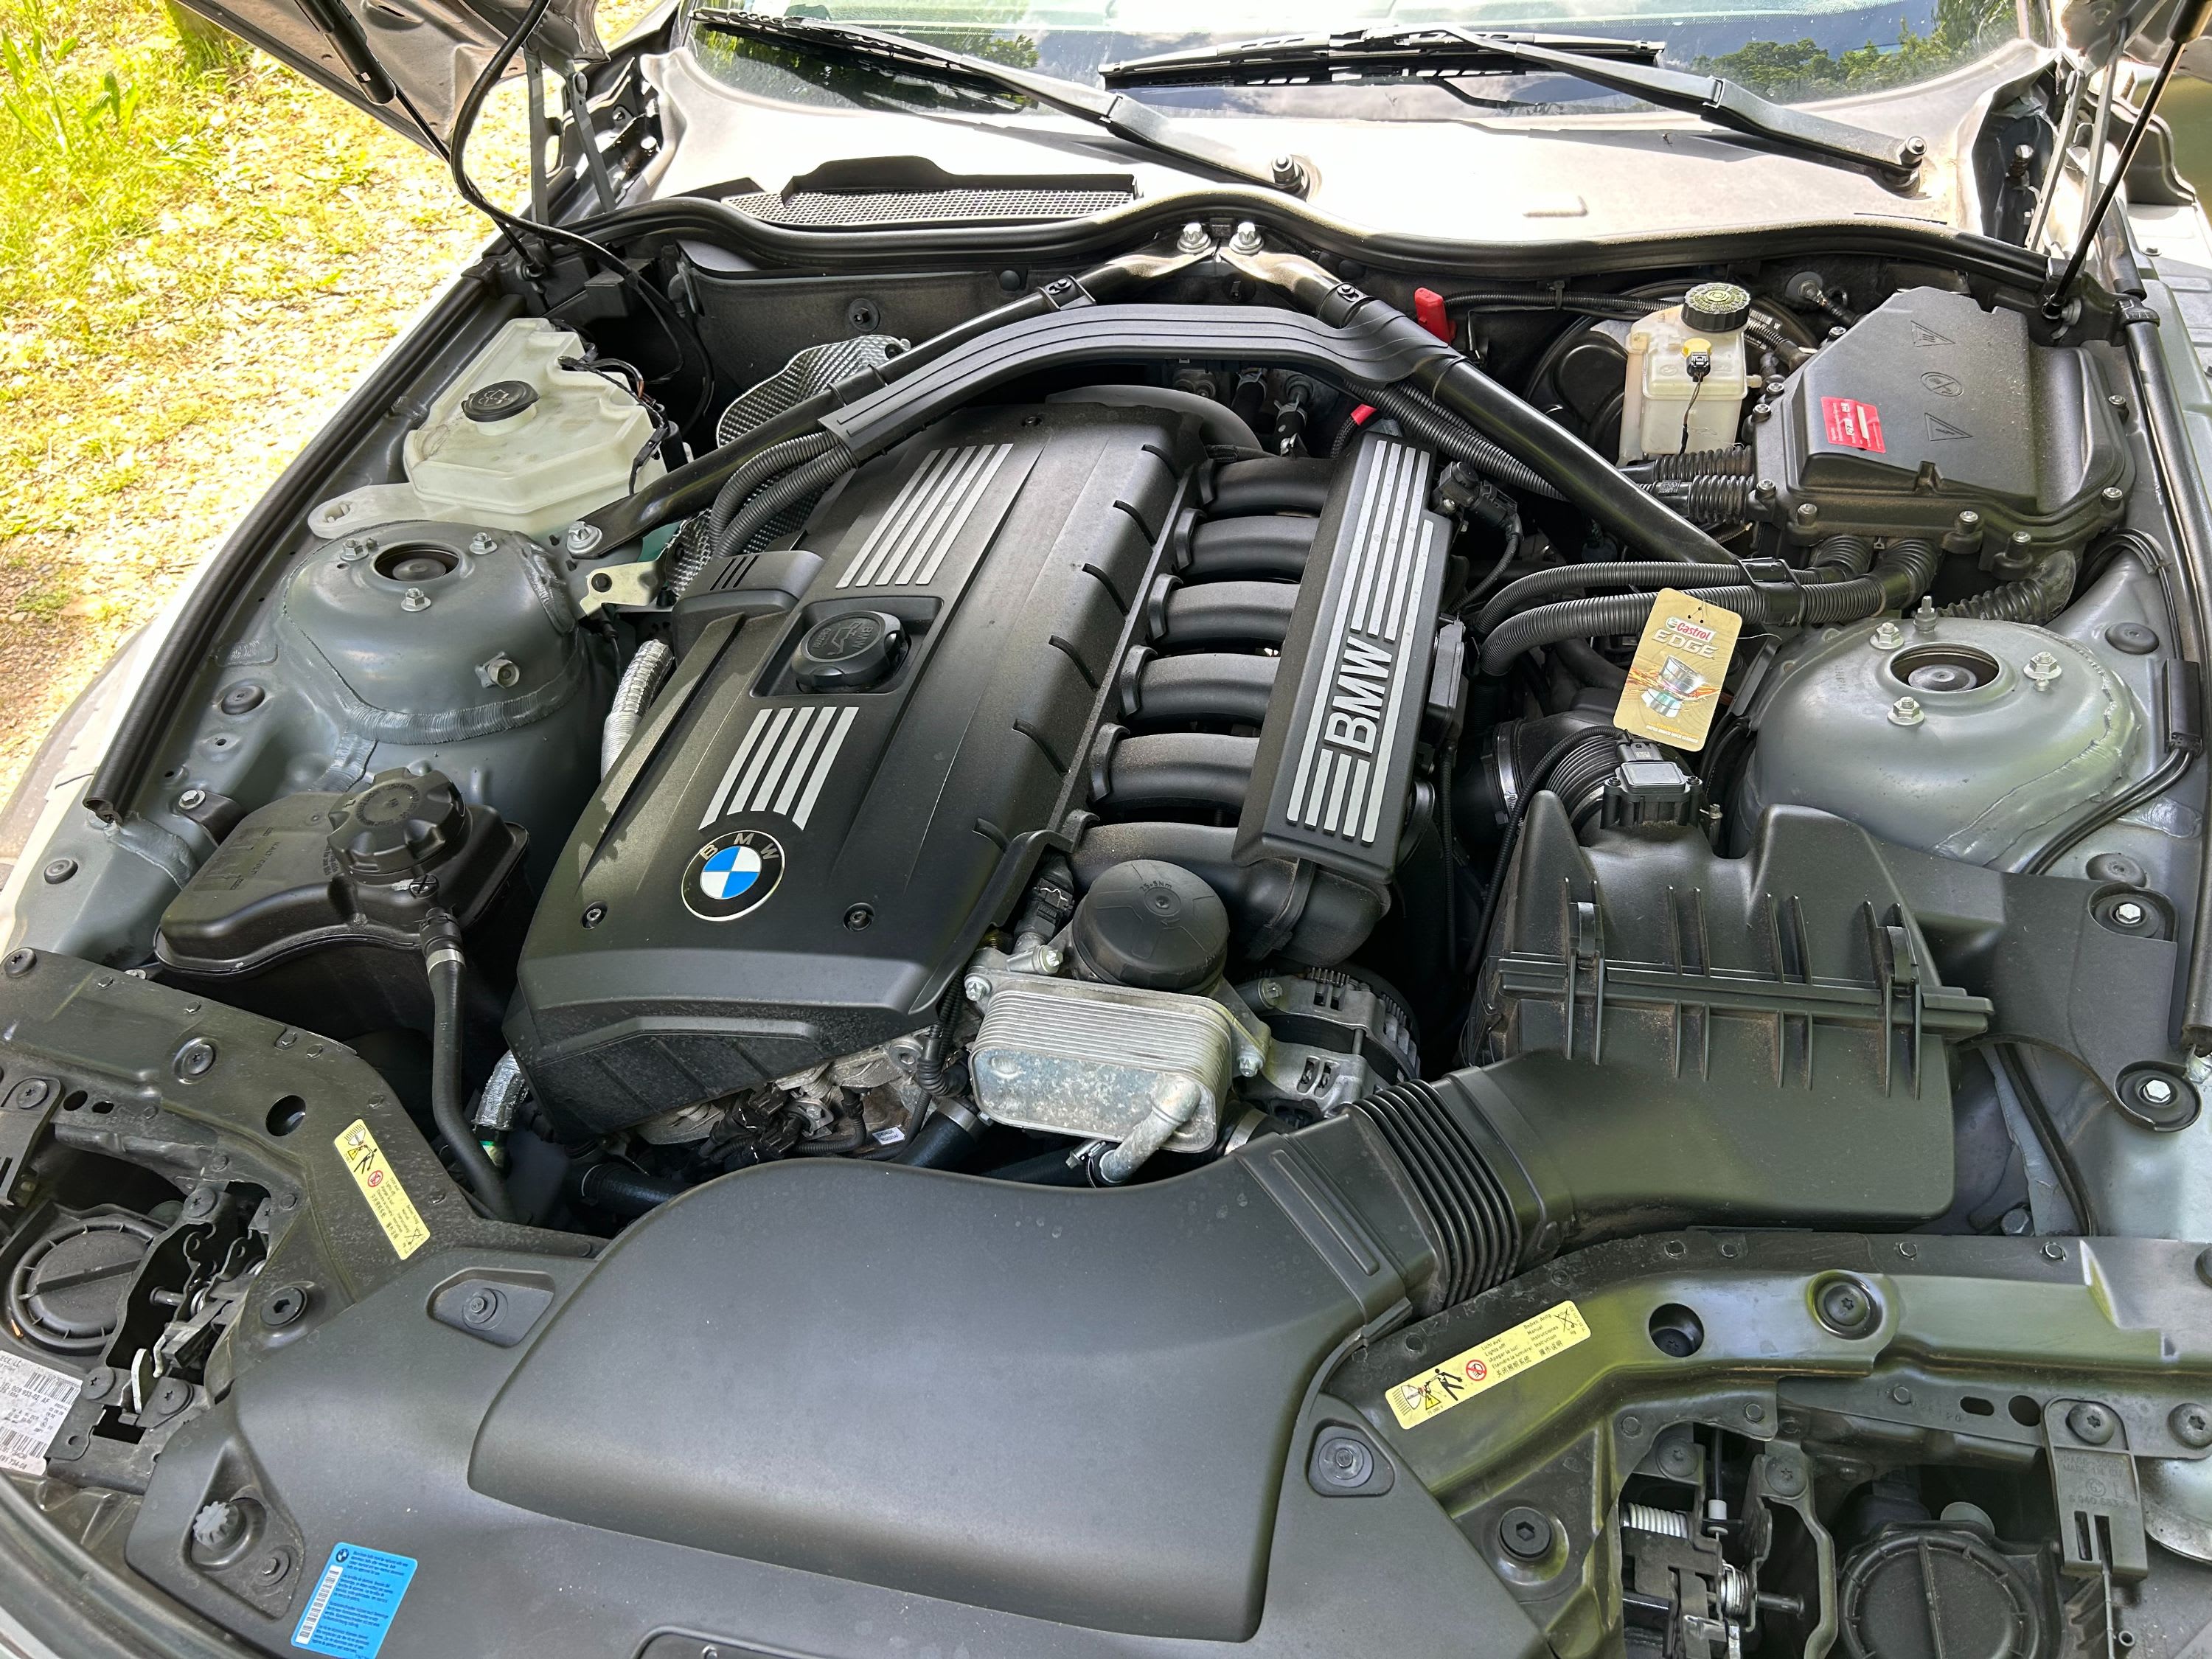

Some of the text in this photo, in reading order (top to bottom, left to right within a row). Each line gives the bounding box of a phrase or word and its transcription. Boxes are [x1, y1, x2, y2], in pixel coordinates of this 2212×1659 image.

[852, 626, 873, 649] BMW
[1652, 628, 1719, 658] EDGE
[1677, 622, 1711, 640] Castrol
[1324, 636, 1393, 754] BMW
[700, 832, 779, 860] BMW
[1527, 1325, 1543, 1335] Manual
